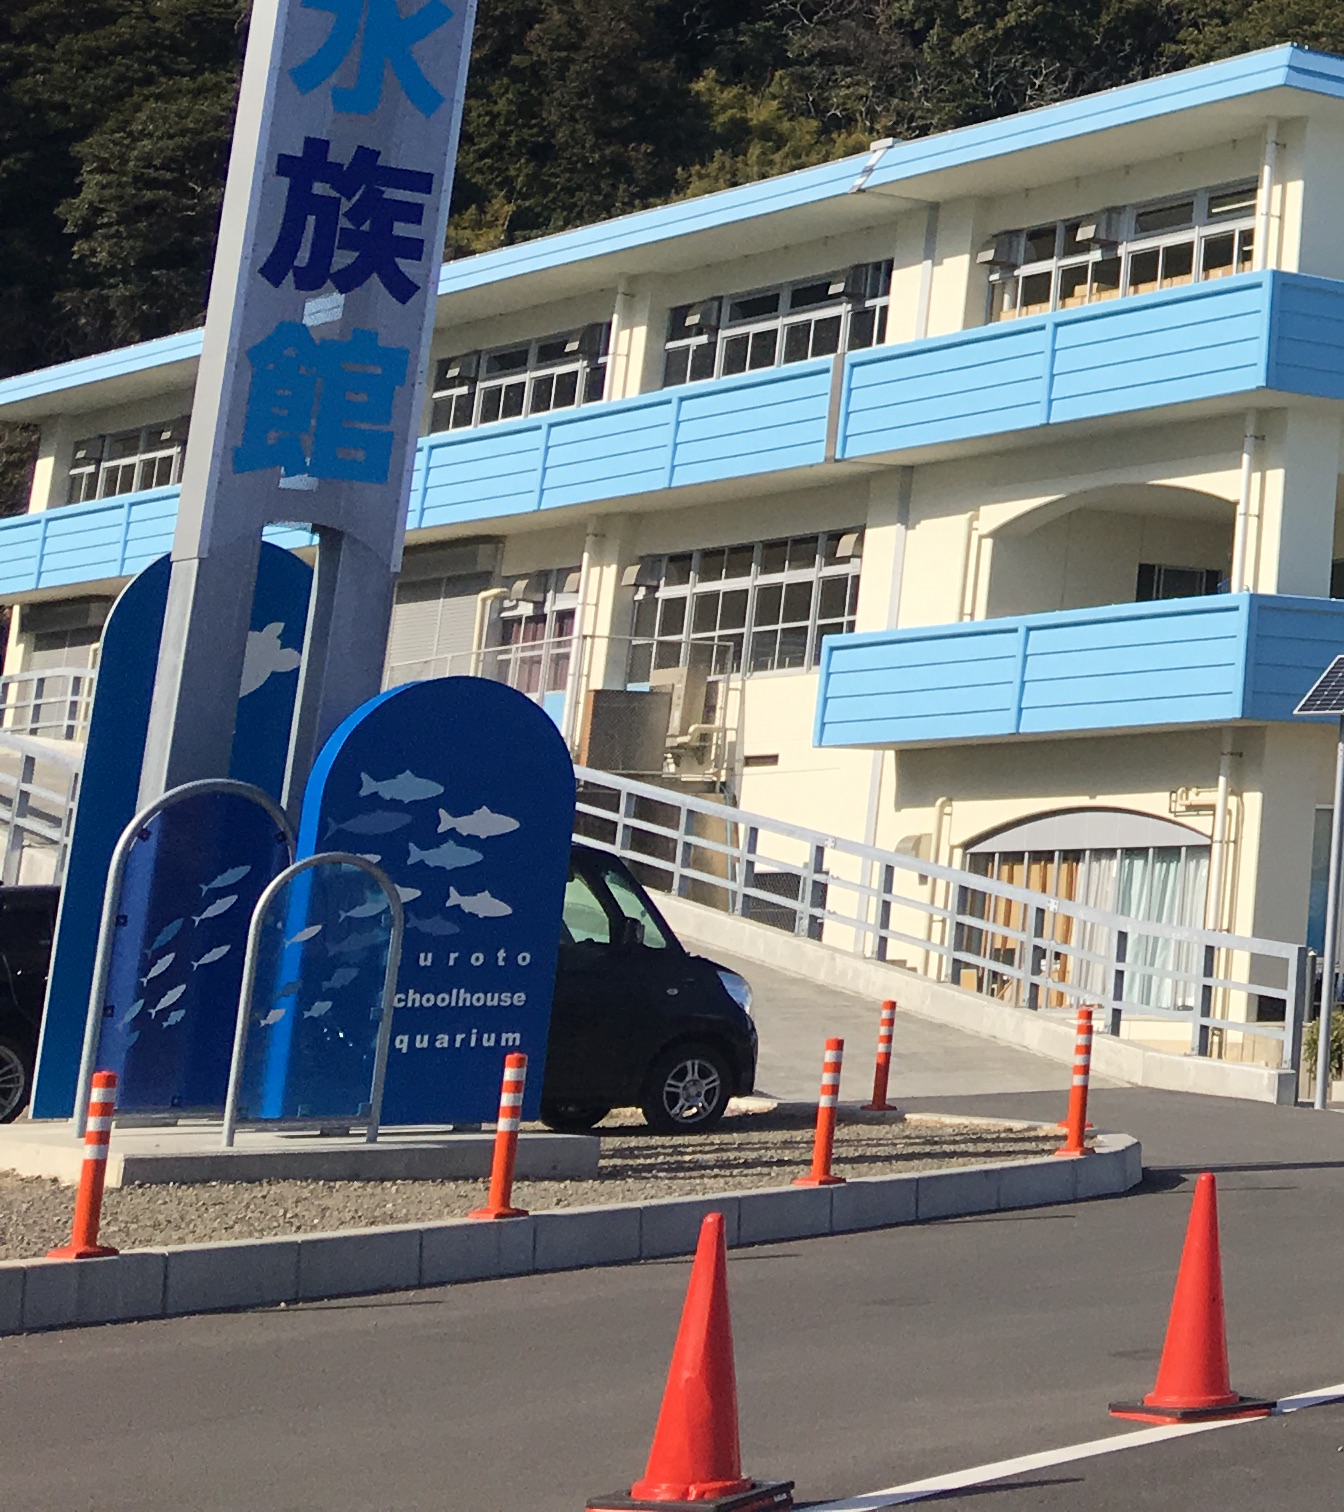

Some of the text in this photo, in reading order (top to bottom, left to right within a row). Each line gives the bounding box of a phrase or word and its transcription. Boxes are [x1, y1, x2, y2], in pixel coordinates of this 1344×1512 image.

[386, 947, 531, 967] uroto
[378, 988, 527, 1007] choolhouse
[373, 1028, 521, 1054] quarium
